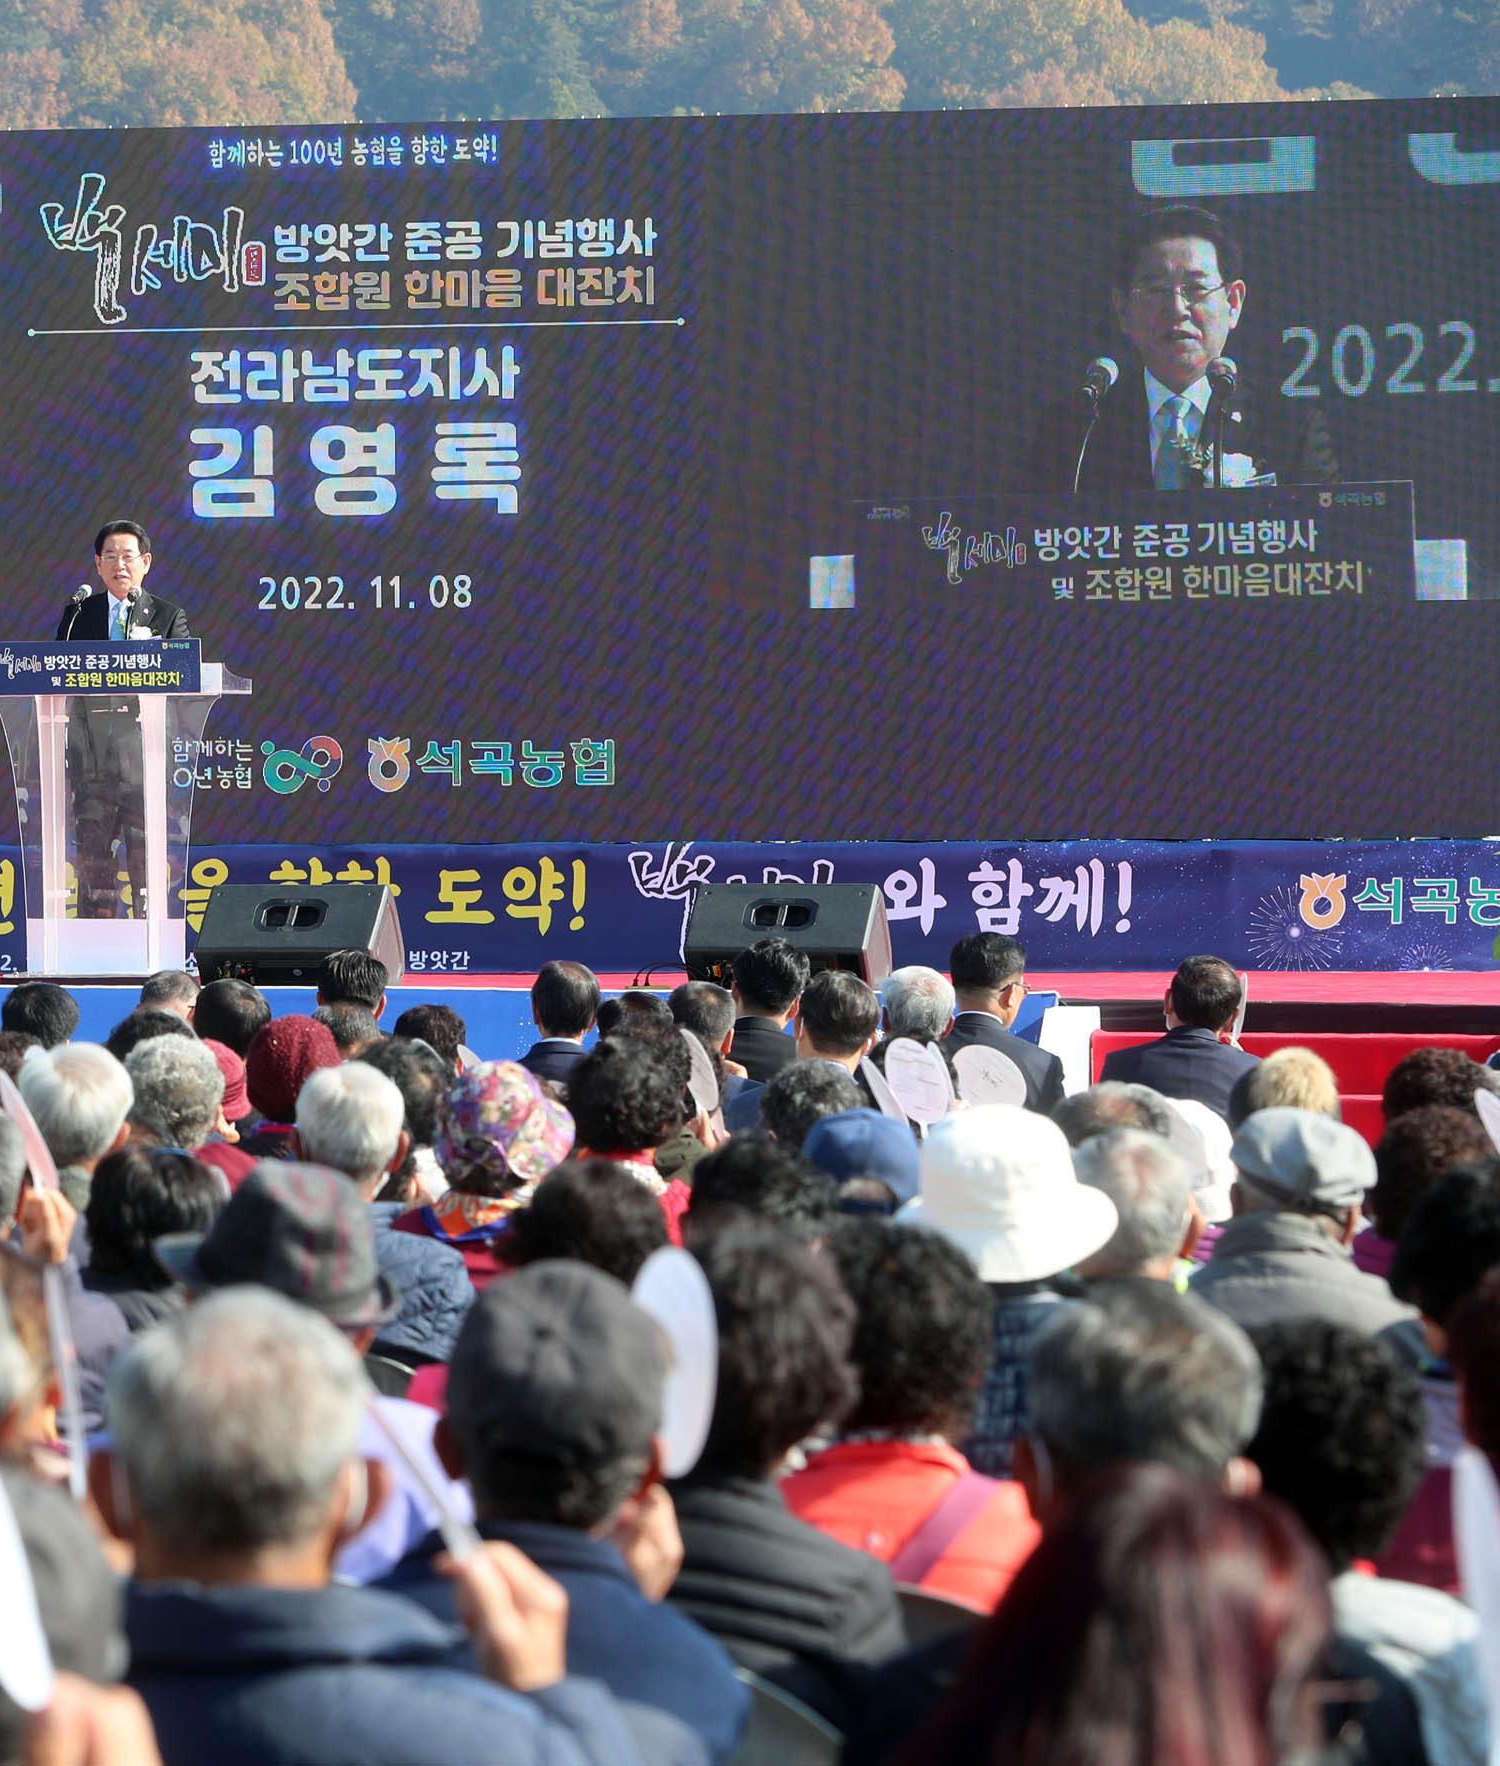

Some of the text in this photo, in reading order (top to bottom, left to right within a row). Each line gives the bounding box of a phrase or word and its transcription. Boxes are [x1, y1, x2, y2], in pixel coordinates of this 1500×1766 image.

[208, 133, 497, 169] 함께하는 100년 농협을 향한 도약!
[274, 222, 394, 263] 방앗간
[404, 221, 483, 261] 준공
[496, 217, 658, 259] 기념행사
[273, 265, 655, 312] 조합원 한마음 대잔치
[190, 345, 521, 404] 전라남도지사
[1280, 320, 1500, 397] 2022.
[1034, 525, 1122, 562] 방앗간
[1132, 523, 1191, 558] 준공
[1197, 519, 1318, 555] 기념행사
[258, 574, 472, 610] 2022. 11. 08
[1051, 561, 1365, 602] 및 조합원 한마음대잔치
[43, 656, 81, 669] 방앗간
[85, 655, 110, 669] 준공
[111, 653, 162, 669] 기념행사
[51, 671, 180, 688] 및 조합원 한마음대잔치
[172, 737, 253, 763] 함께하는
[416, 738, 615, 788] 석곡농협
[217, 763, 252, 789] 농협
[424, 855, 588, 936] 도약!
[968, 857, 1133, 937] 함께!
[409, 950, 471, 971] 방앗간
